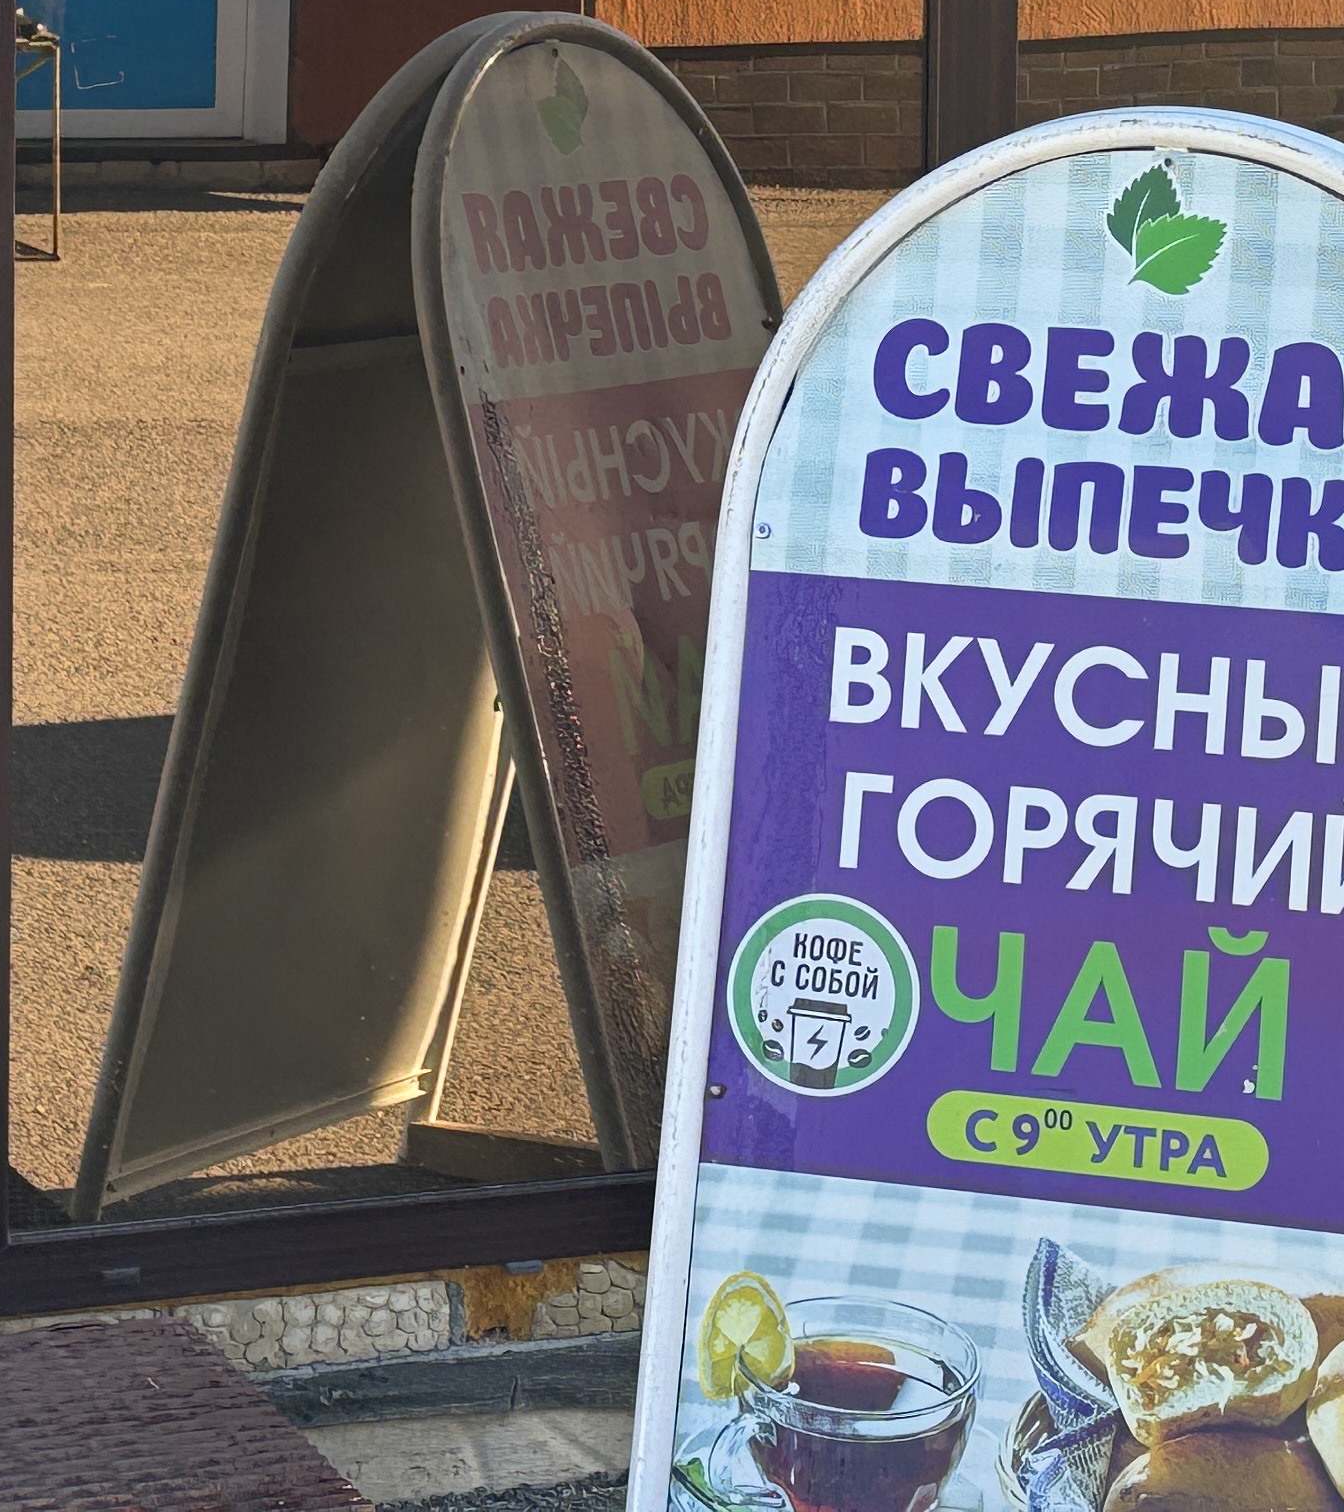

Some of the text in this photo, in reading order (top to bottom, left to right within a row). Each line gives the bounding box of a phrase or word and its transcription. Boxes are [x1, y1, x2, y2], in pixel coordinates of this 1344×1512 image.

[792, 932, 864, 966] КОФЕ
[770, 960, 879, 1000] С СОБОЙ
[930, 925, 1291, 1101] ЧАЙ
[965, 1109, 999, 1153] С
[1085, 1120, 1228, 1178] УТРА
